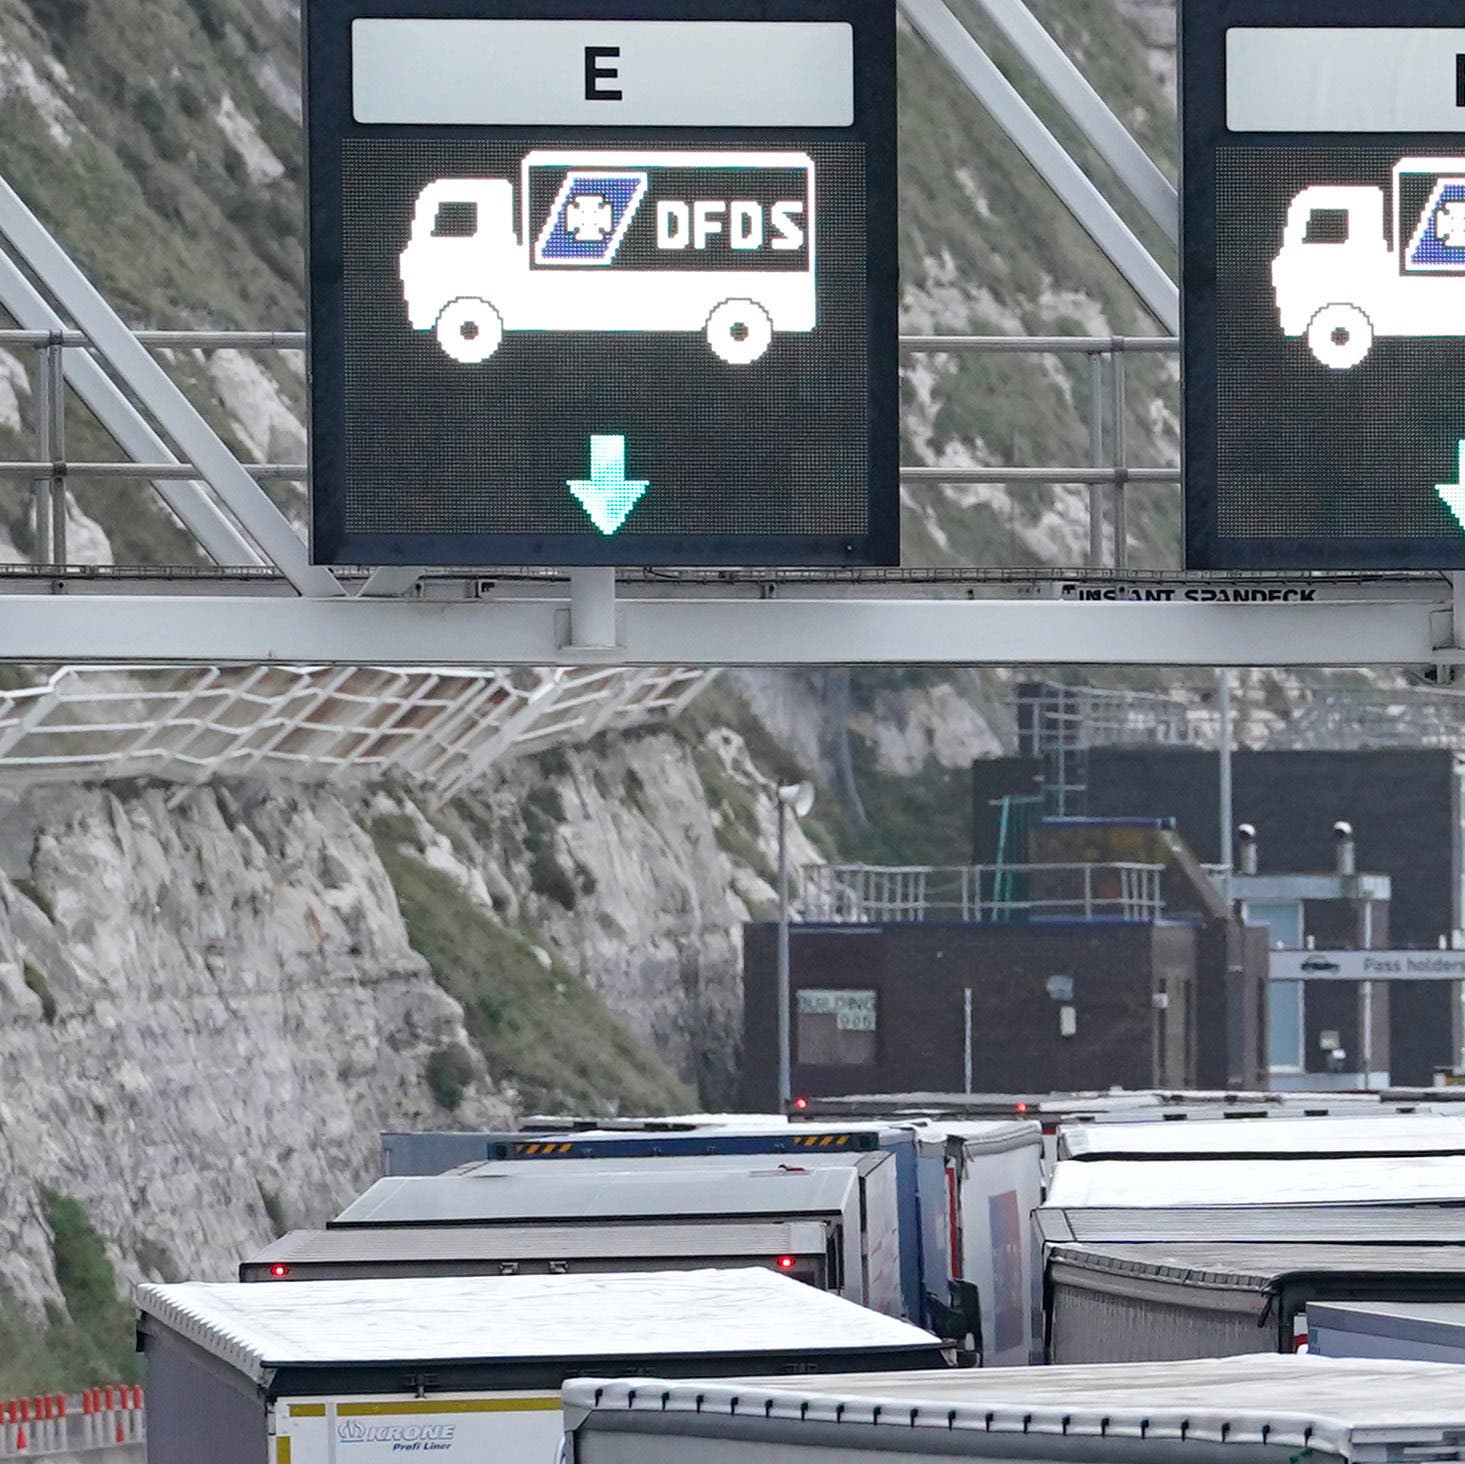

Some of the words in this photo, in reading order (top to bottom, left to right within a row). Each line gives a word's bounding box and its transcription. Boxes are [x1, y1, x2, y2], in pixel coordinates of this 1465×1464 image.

[585, 47, 622, 101] E
[656, 200, 804, 251] DFDS
[366, 1423, 456, 1442] KRONE
[392, 1442, 421, 1452] Profi
[423, 1442, 452, 1451] Liner
